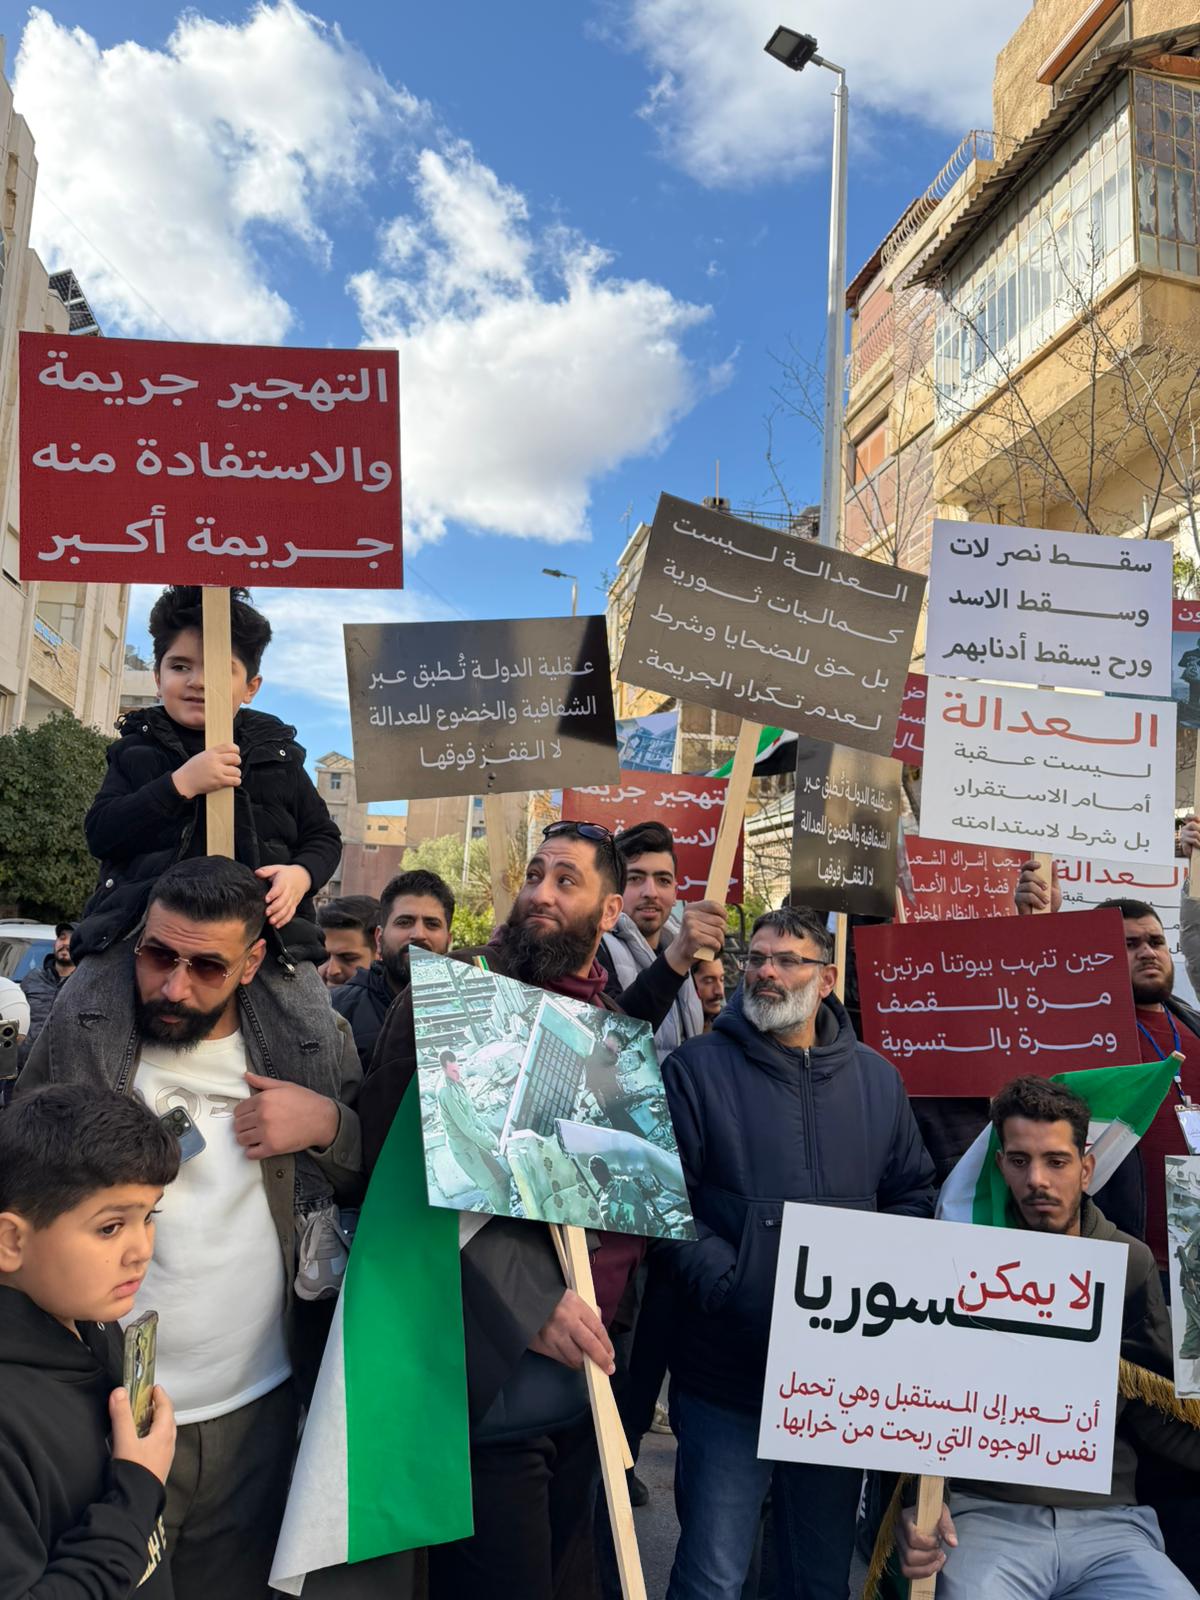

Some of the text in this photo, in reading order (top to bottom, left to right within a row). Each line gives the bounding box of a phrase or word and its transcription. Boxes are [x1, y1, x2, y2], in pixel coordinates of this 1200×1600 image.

[38, 350, 388, 412] التهجير جريمة
[32, 437, 393, 492] والاستفادة منه
[38, 504, 394, 569] جريمة أكبر
[672, 518, 908, 603] العدالة ليست
[949, 537, 1152, 573] سقط نصر لات
[663, 558, 904, 644] كماليات ثورية
[949, 587, 1008, 609] الاسد
[1017, 590, 1150, 627] وسقط
[651, 604, 889, 693] بل حق للضحايا وشرط
[942, 632, 1153, 679] ورح يسقط أدنابهم
[369, 669, 407, 689] عبر
[472, 657, 533, 684] الدولة
[539, 656, 594, 681] عقلية
[638, 649, 733, 690] الجريمة.
[735, 680, 805, 710] تكرار
[370, 695, 597, 731] الشفافية والخضوع للعدالة
[805, 704, 882, 732] لعدم
[942, 691, 1158, 747] العدالة
[420, 738, 562, 771] لا القفز فوقها
[954, 742, 1152, 778] ليست عقبة
[1072, 794, 1151, 814] أمام
[951, 816, 1150, 852] بل شرط لاستدامته
[951, 877, 980, 898] رجال
[940, 952, 994, 980] بيوتنا
[1000, 949, 1058, 976] تنهب
[1066, 951, 1114, 974] حين
[876, 987, 1112, 1015] مرة بالقصف
[881, 1027, 1118, 1057] ومرة بالتسوية
[794, 1245, 1105, 1343] لسوريا
[958, 1261, 1092, 1319] لا يمكن
[778, 1371, 1101, 1432] أن تعبر إلى المستقبل وهي تحمل
[842, 1420, 874, 1444] من
[879, 1420, 932, 1450] ربحت
[937, 1426, 972, 1462] التي
[978, 1433, 1040, 1460] الوجوه
[1045, 1441, 1097, 1465] نفس
